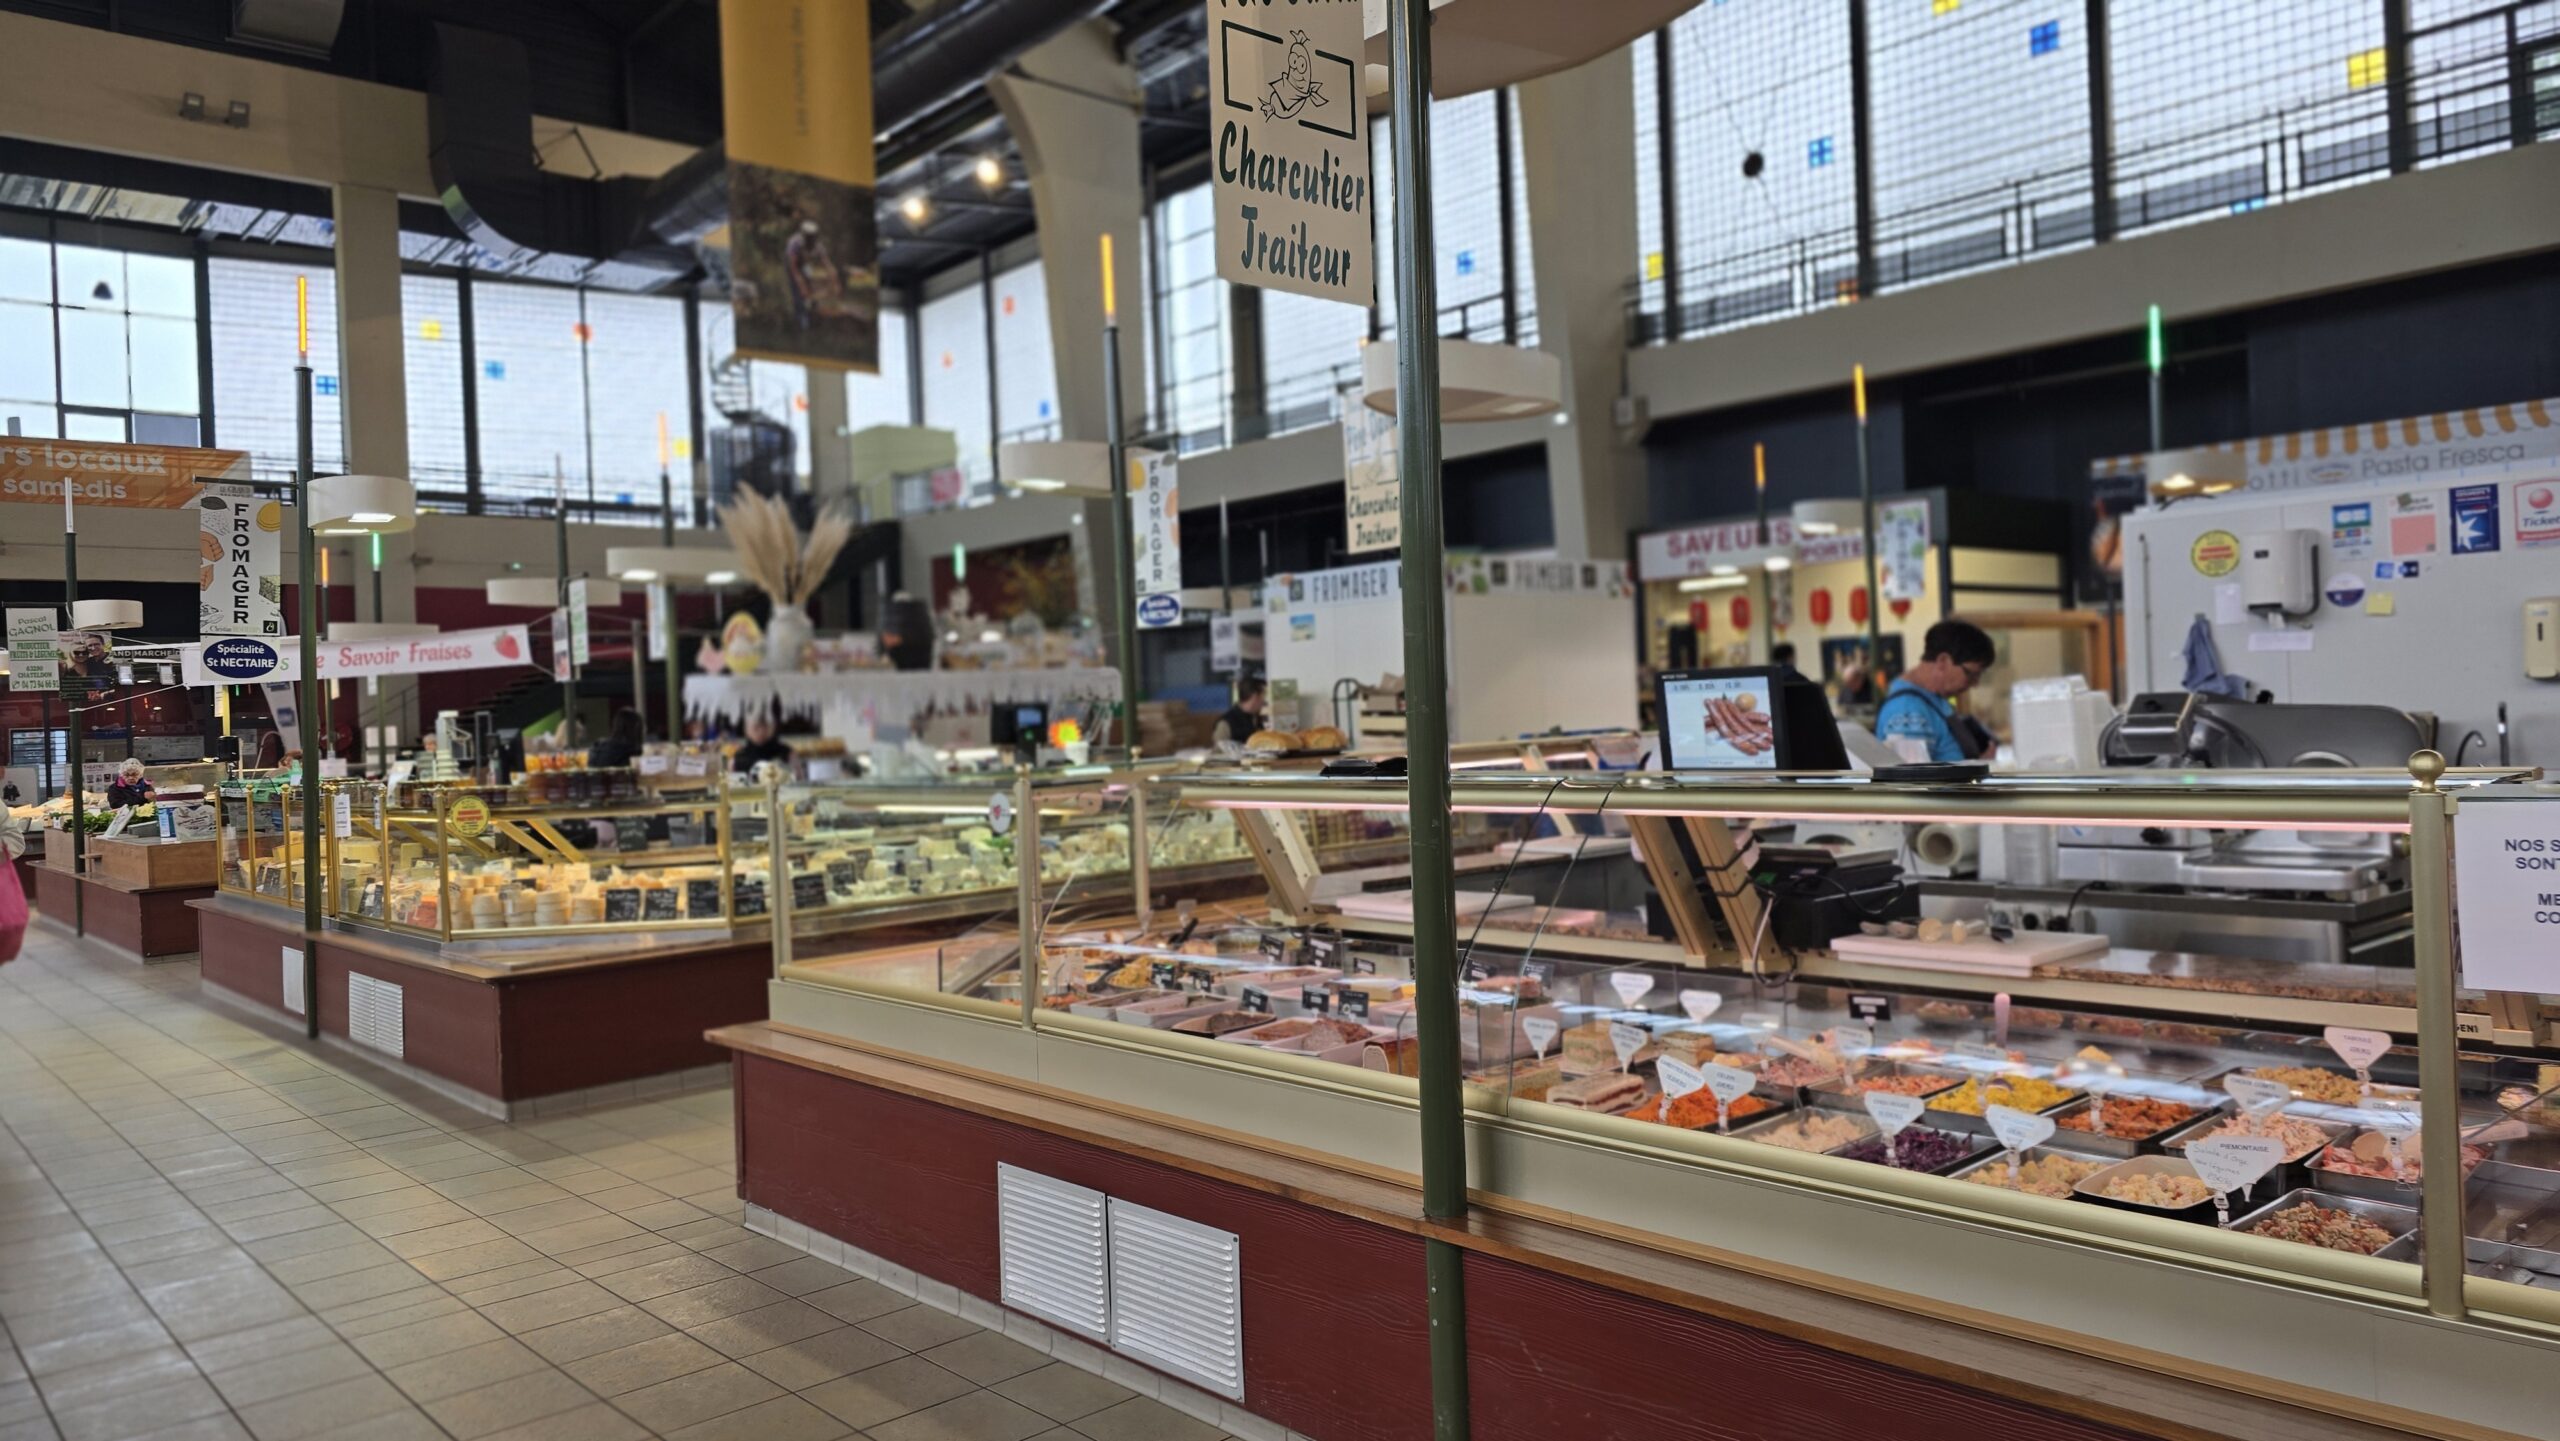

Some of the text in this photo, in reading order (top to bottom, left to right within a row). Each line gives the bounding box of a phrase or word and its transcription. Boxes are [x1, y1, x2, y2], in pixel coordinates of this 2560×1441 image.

[1219, 120, 1365, 214] Charcutier
[1241, 204, 1351, 288] Traiteur
[45, 444, 168, 474] locaux
[2361, 443, 2525, 478] Pasta Fresca
[3, 477, 128, 499] samedis
[1148, 459, 1163, 583] FROMAGER
[231, 503, 250, 624] FROMAGER
[1313, 568, 1388, 602] FROMAGER
[8, 623, 56, 637] GAGNOL
[206, 657, 275, 668] St NECTAIRE
[217, 643, 265, 655] Spécialité
[338, 646, 400, 668] Savoir
[407, 642, 472, 664] Fraises
[2504, 838, 2545, 852] NOS
[2219, 1142, 2270, 1153] PIEMONTAISE
